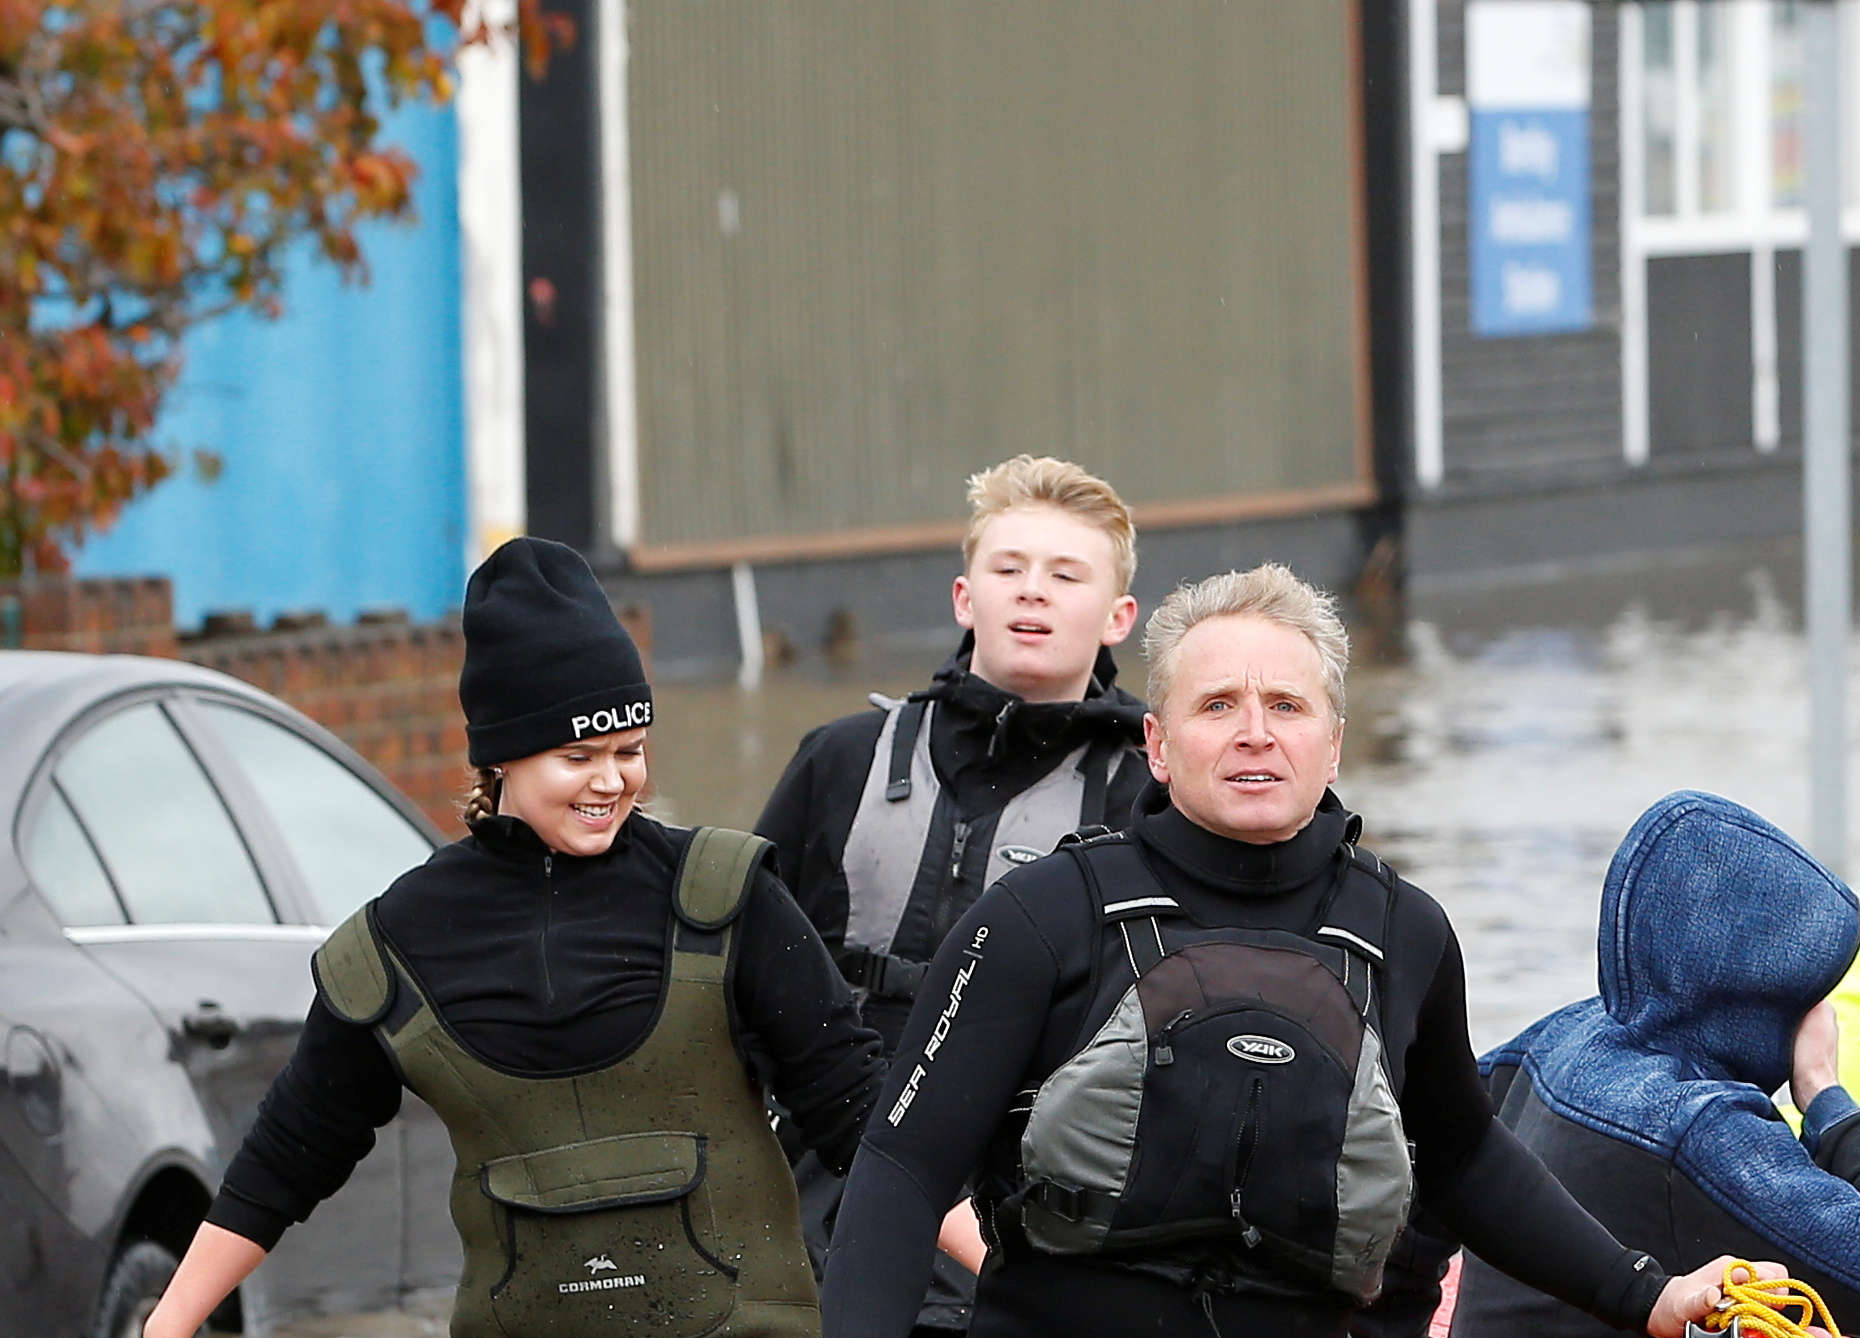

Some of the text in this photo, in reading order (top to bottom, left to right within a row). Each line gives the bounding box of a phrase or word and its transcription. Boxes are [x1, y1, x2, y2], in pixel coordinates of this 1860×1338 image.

[571, 702, 651, 738] POLICE
[888, 926, 989, 1127] SEA ROYAL HD
[1240, 1040, 1283, 1058] YAK
[559, 1275, 645, 1293] CORMORAN
